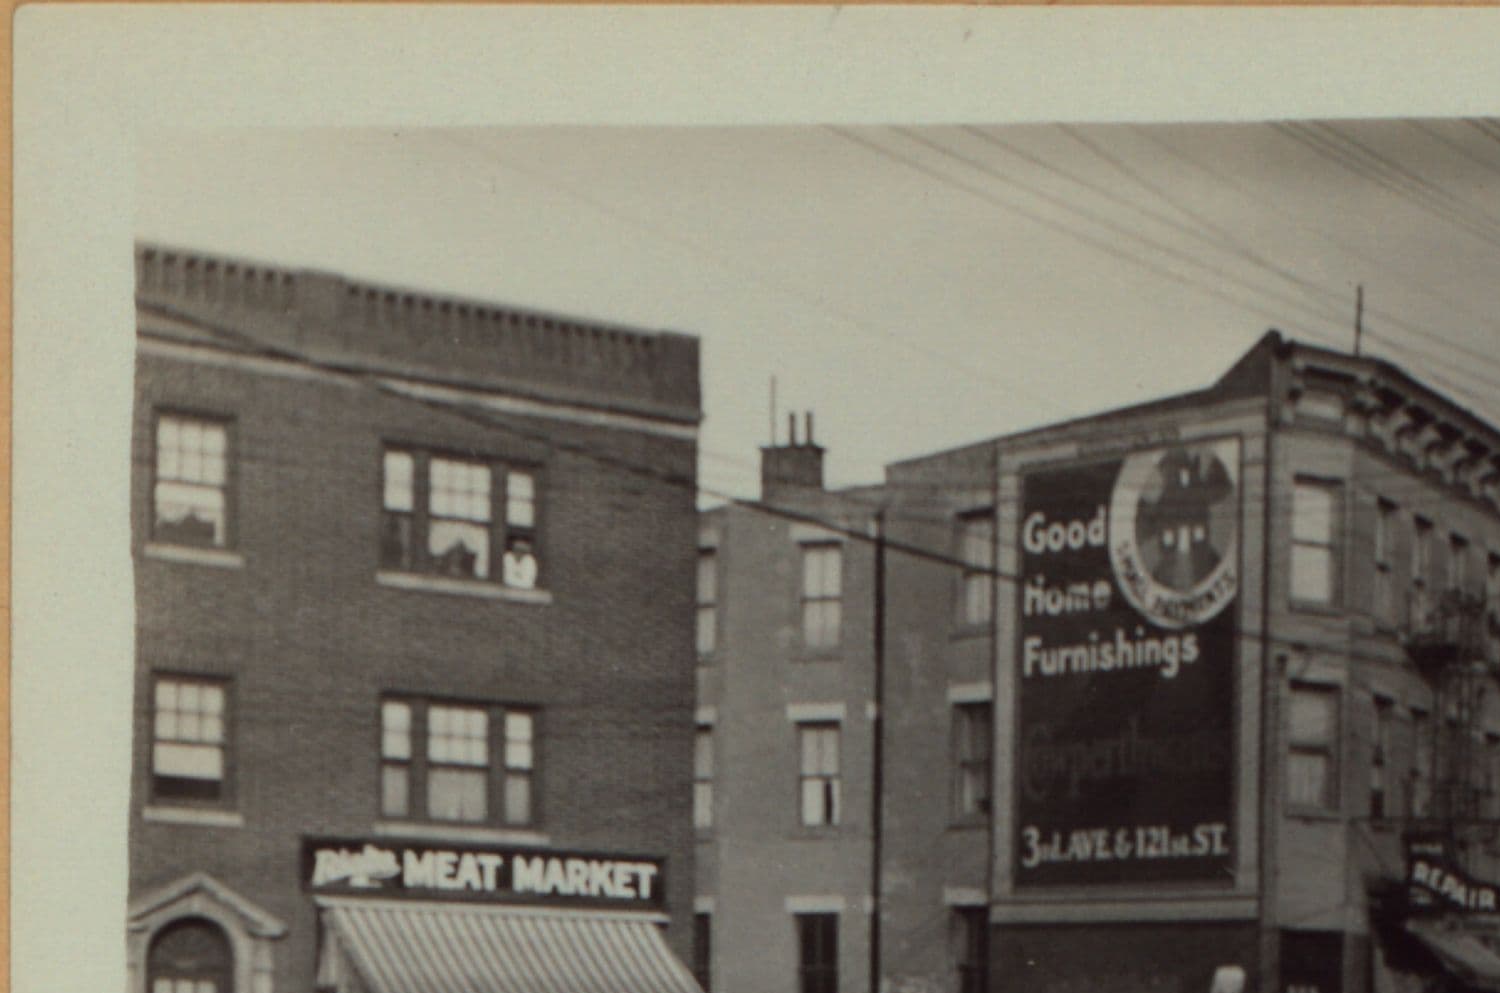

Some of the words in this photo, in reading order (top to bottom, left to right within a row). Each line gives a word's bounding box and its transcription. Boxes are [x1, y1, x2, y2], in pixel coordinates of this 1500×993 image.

[1023, 504, 1107, 553] Good
[1023, 573, 1112, 616] Home
[1022, 627, 1199, 680] Furnishings
[403, 848, 503, 891] MEAT
[512, 855, 659, 899] MARKET
